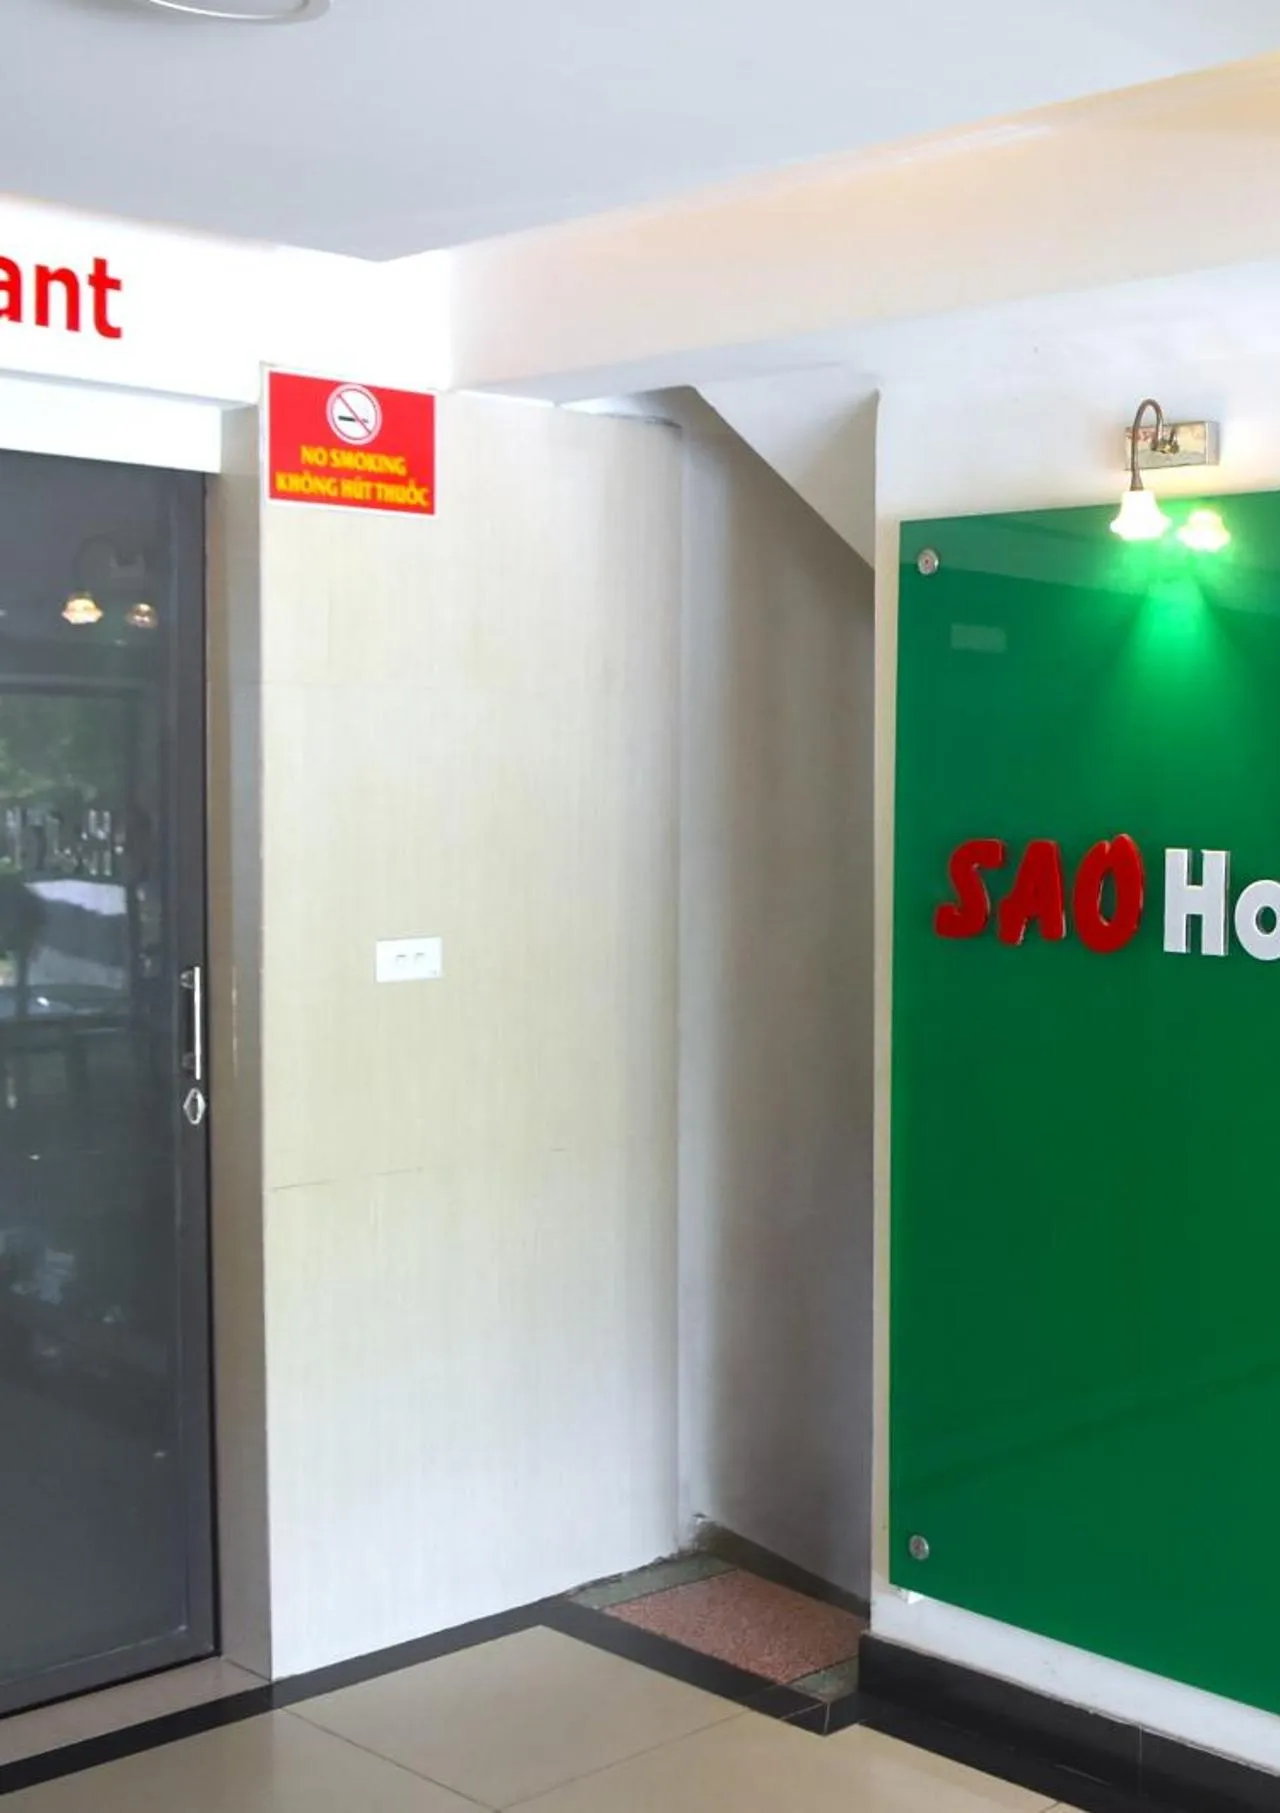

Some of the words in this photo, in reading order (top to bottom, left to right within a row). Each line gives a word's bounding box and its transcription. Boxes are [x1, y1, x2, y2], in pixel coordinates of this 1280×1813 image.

[300, 445, 327, 467] NO
[330, 449, 407, 476] SMOKING
[935, 834, 1144, 953] SAO
